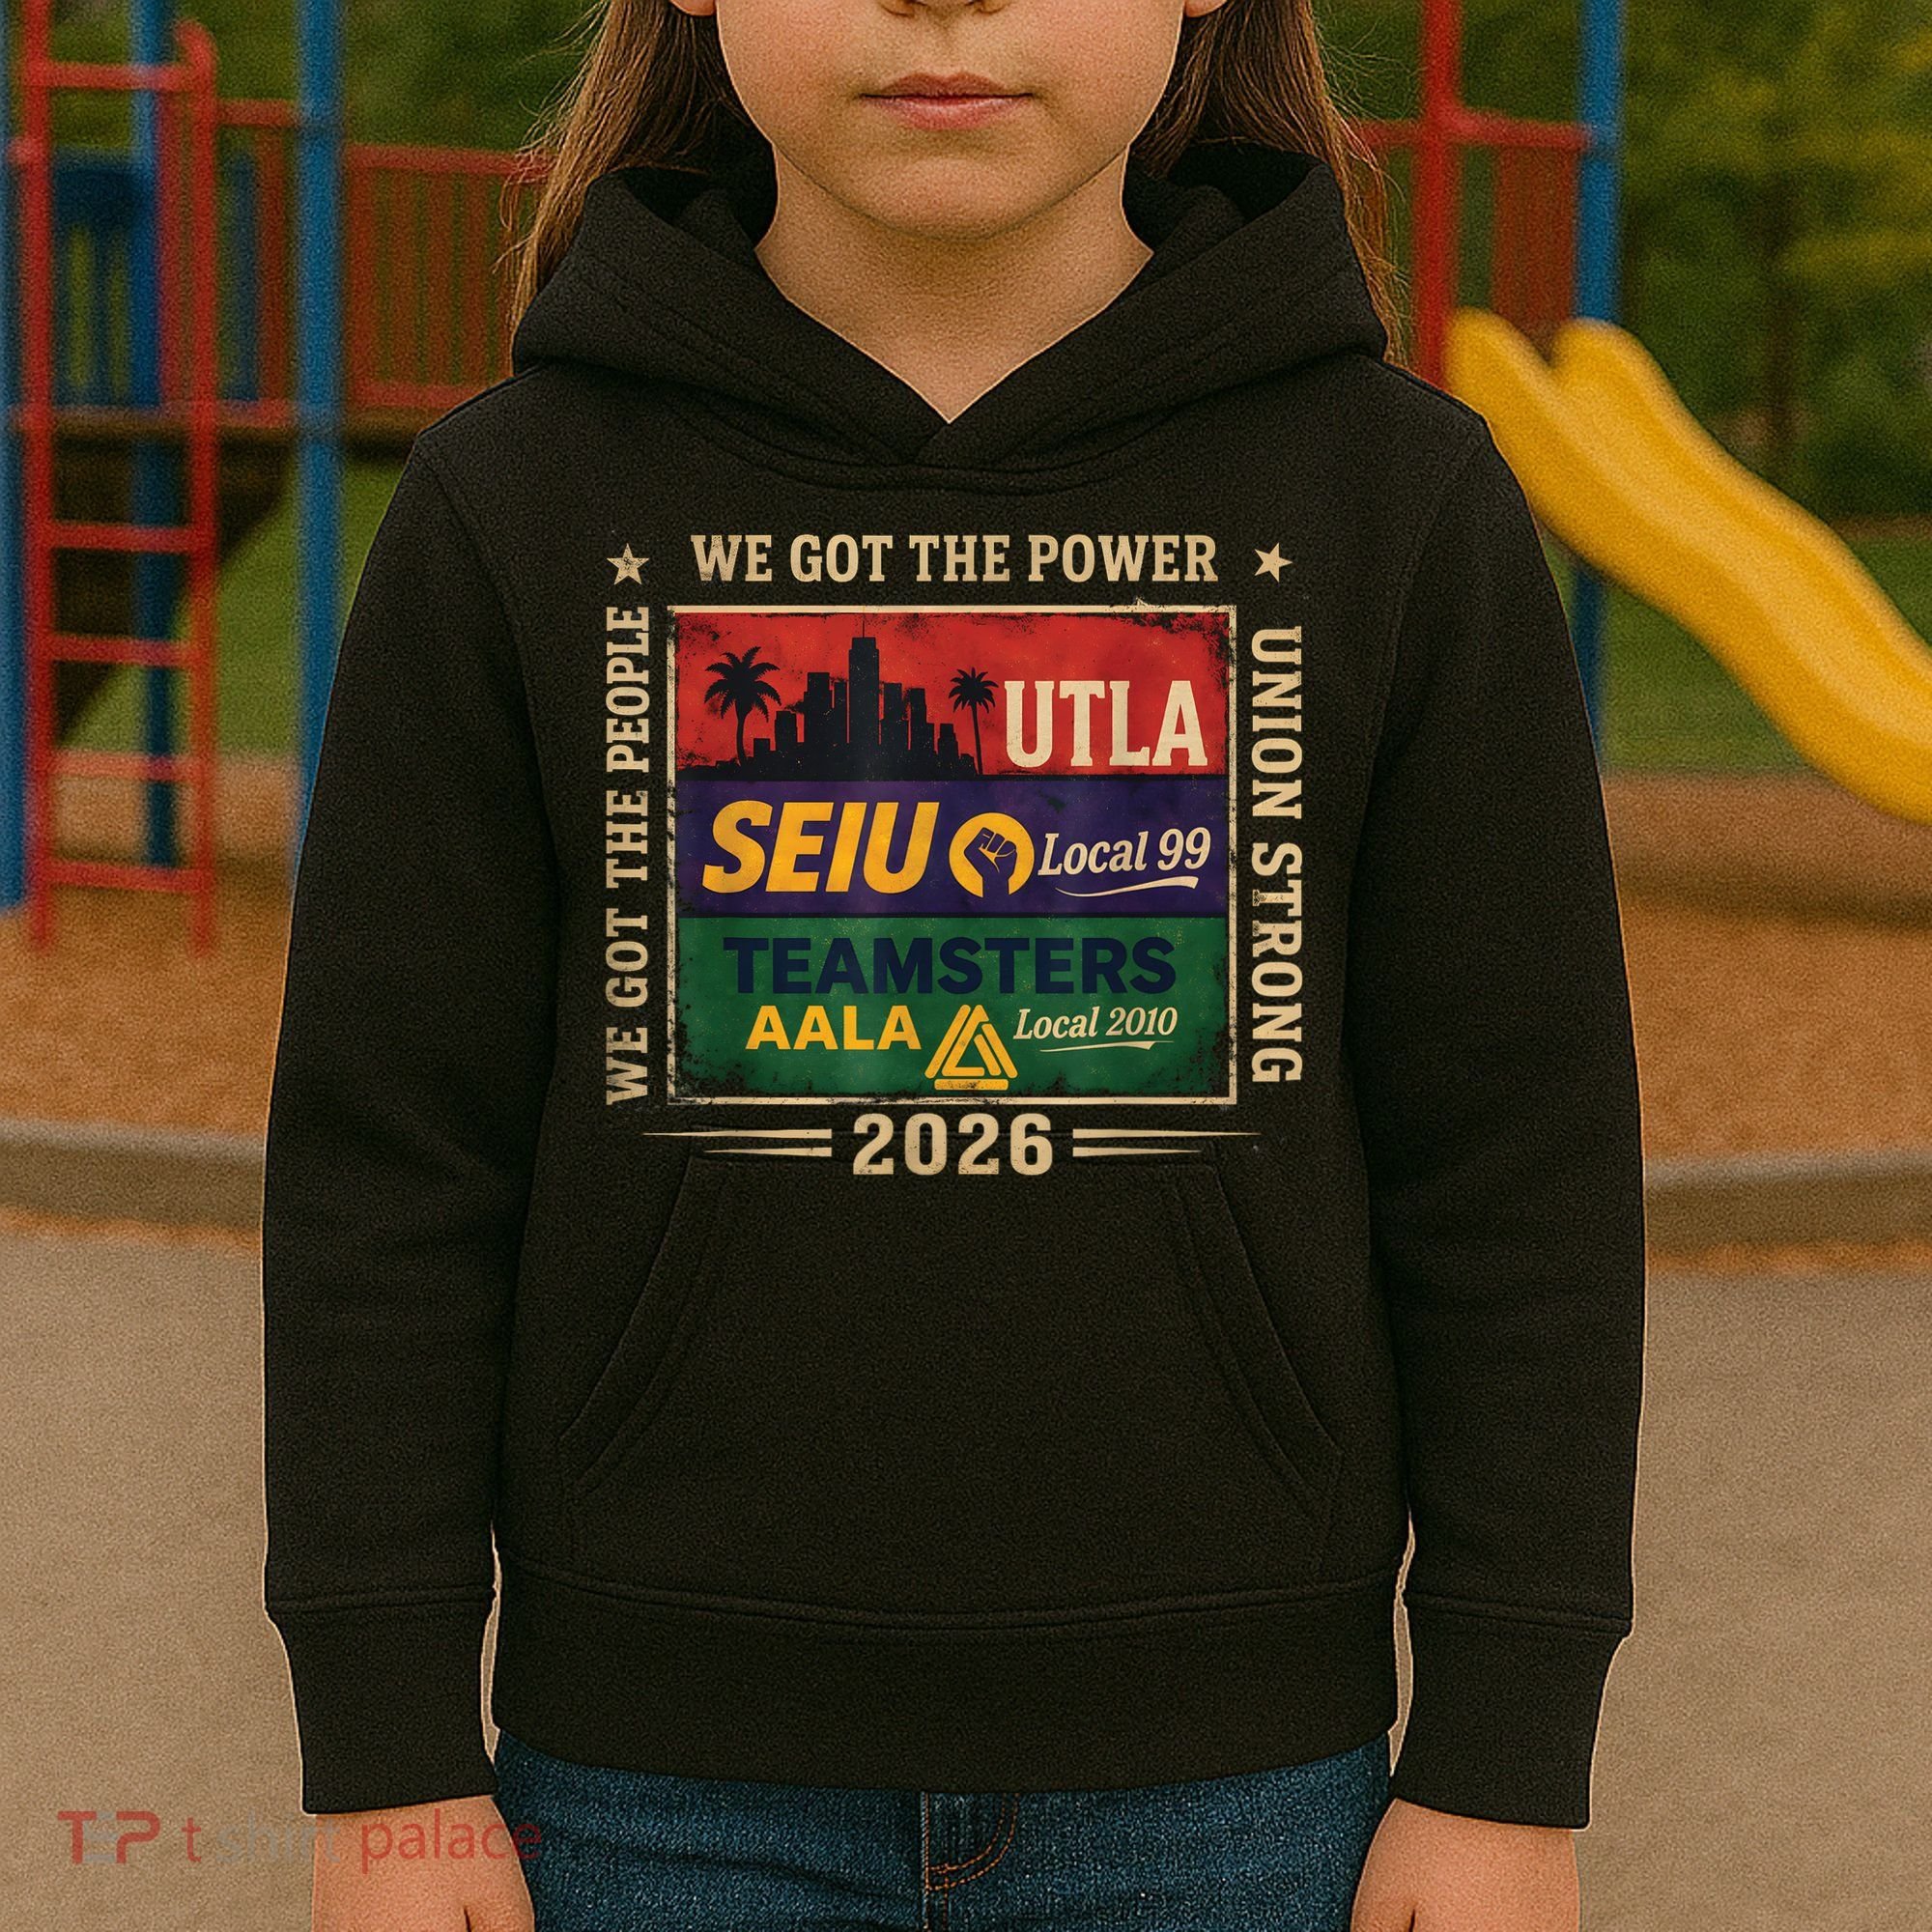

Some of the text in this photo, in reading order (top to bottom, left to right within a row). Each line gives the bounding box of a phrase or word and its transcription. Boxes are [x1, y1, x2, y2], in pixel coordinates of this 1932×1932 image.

[691, 533, 1218, 583] WE GOT THE POWER
[1005, 679, 1208, 768] UTLA
[606, 605, 649, 1106] WE GOT THE PEOPLE
[702, 800, 1211, 895] SEIU Local 99
[1251, 625, 1302, 1084] UNION STRONG
[724, 937, 1177, 995] TEAMSTERS
[746, 1005, 1178, 1051] AALA Local 2010
[853, 1113, 1054, 1176] 2026
